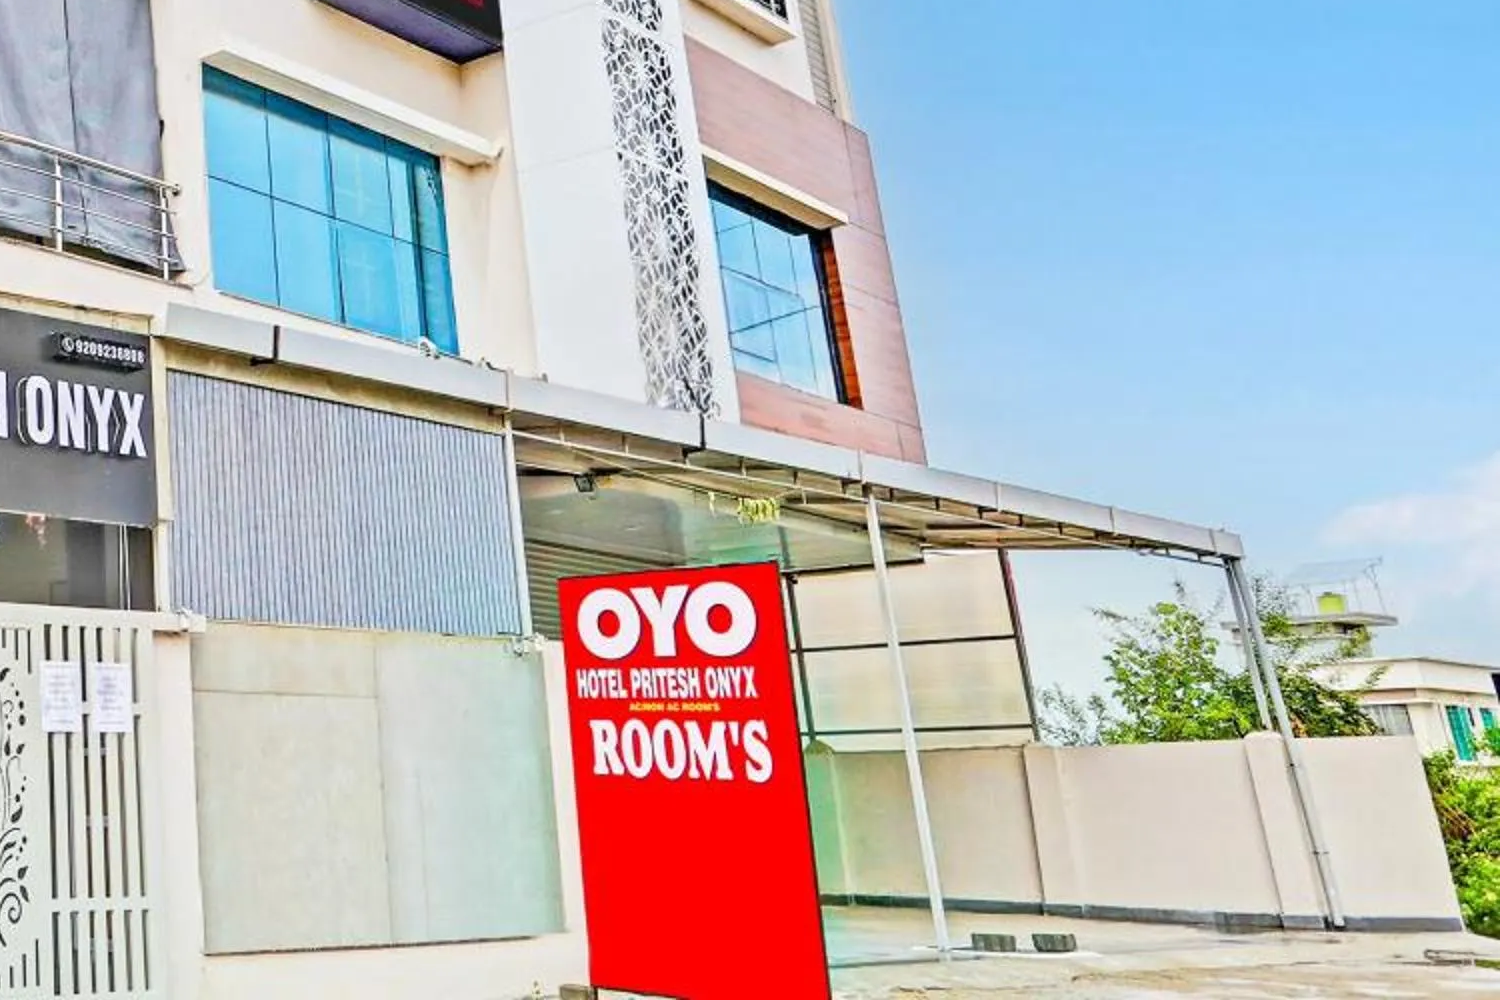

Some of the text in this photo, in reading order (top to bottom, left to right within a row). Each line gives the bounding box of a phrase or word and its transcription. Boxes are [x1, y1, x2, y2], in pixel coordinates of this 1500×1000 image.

[21, 374, 147, 458] ONYX
[577, 581, 757, 660] OYO
[575, 665, 758, 699] HOTEL PRITESH ONYX
[589, 718, 773, 783] ROOM'S
